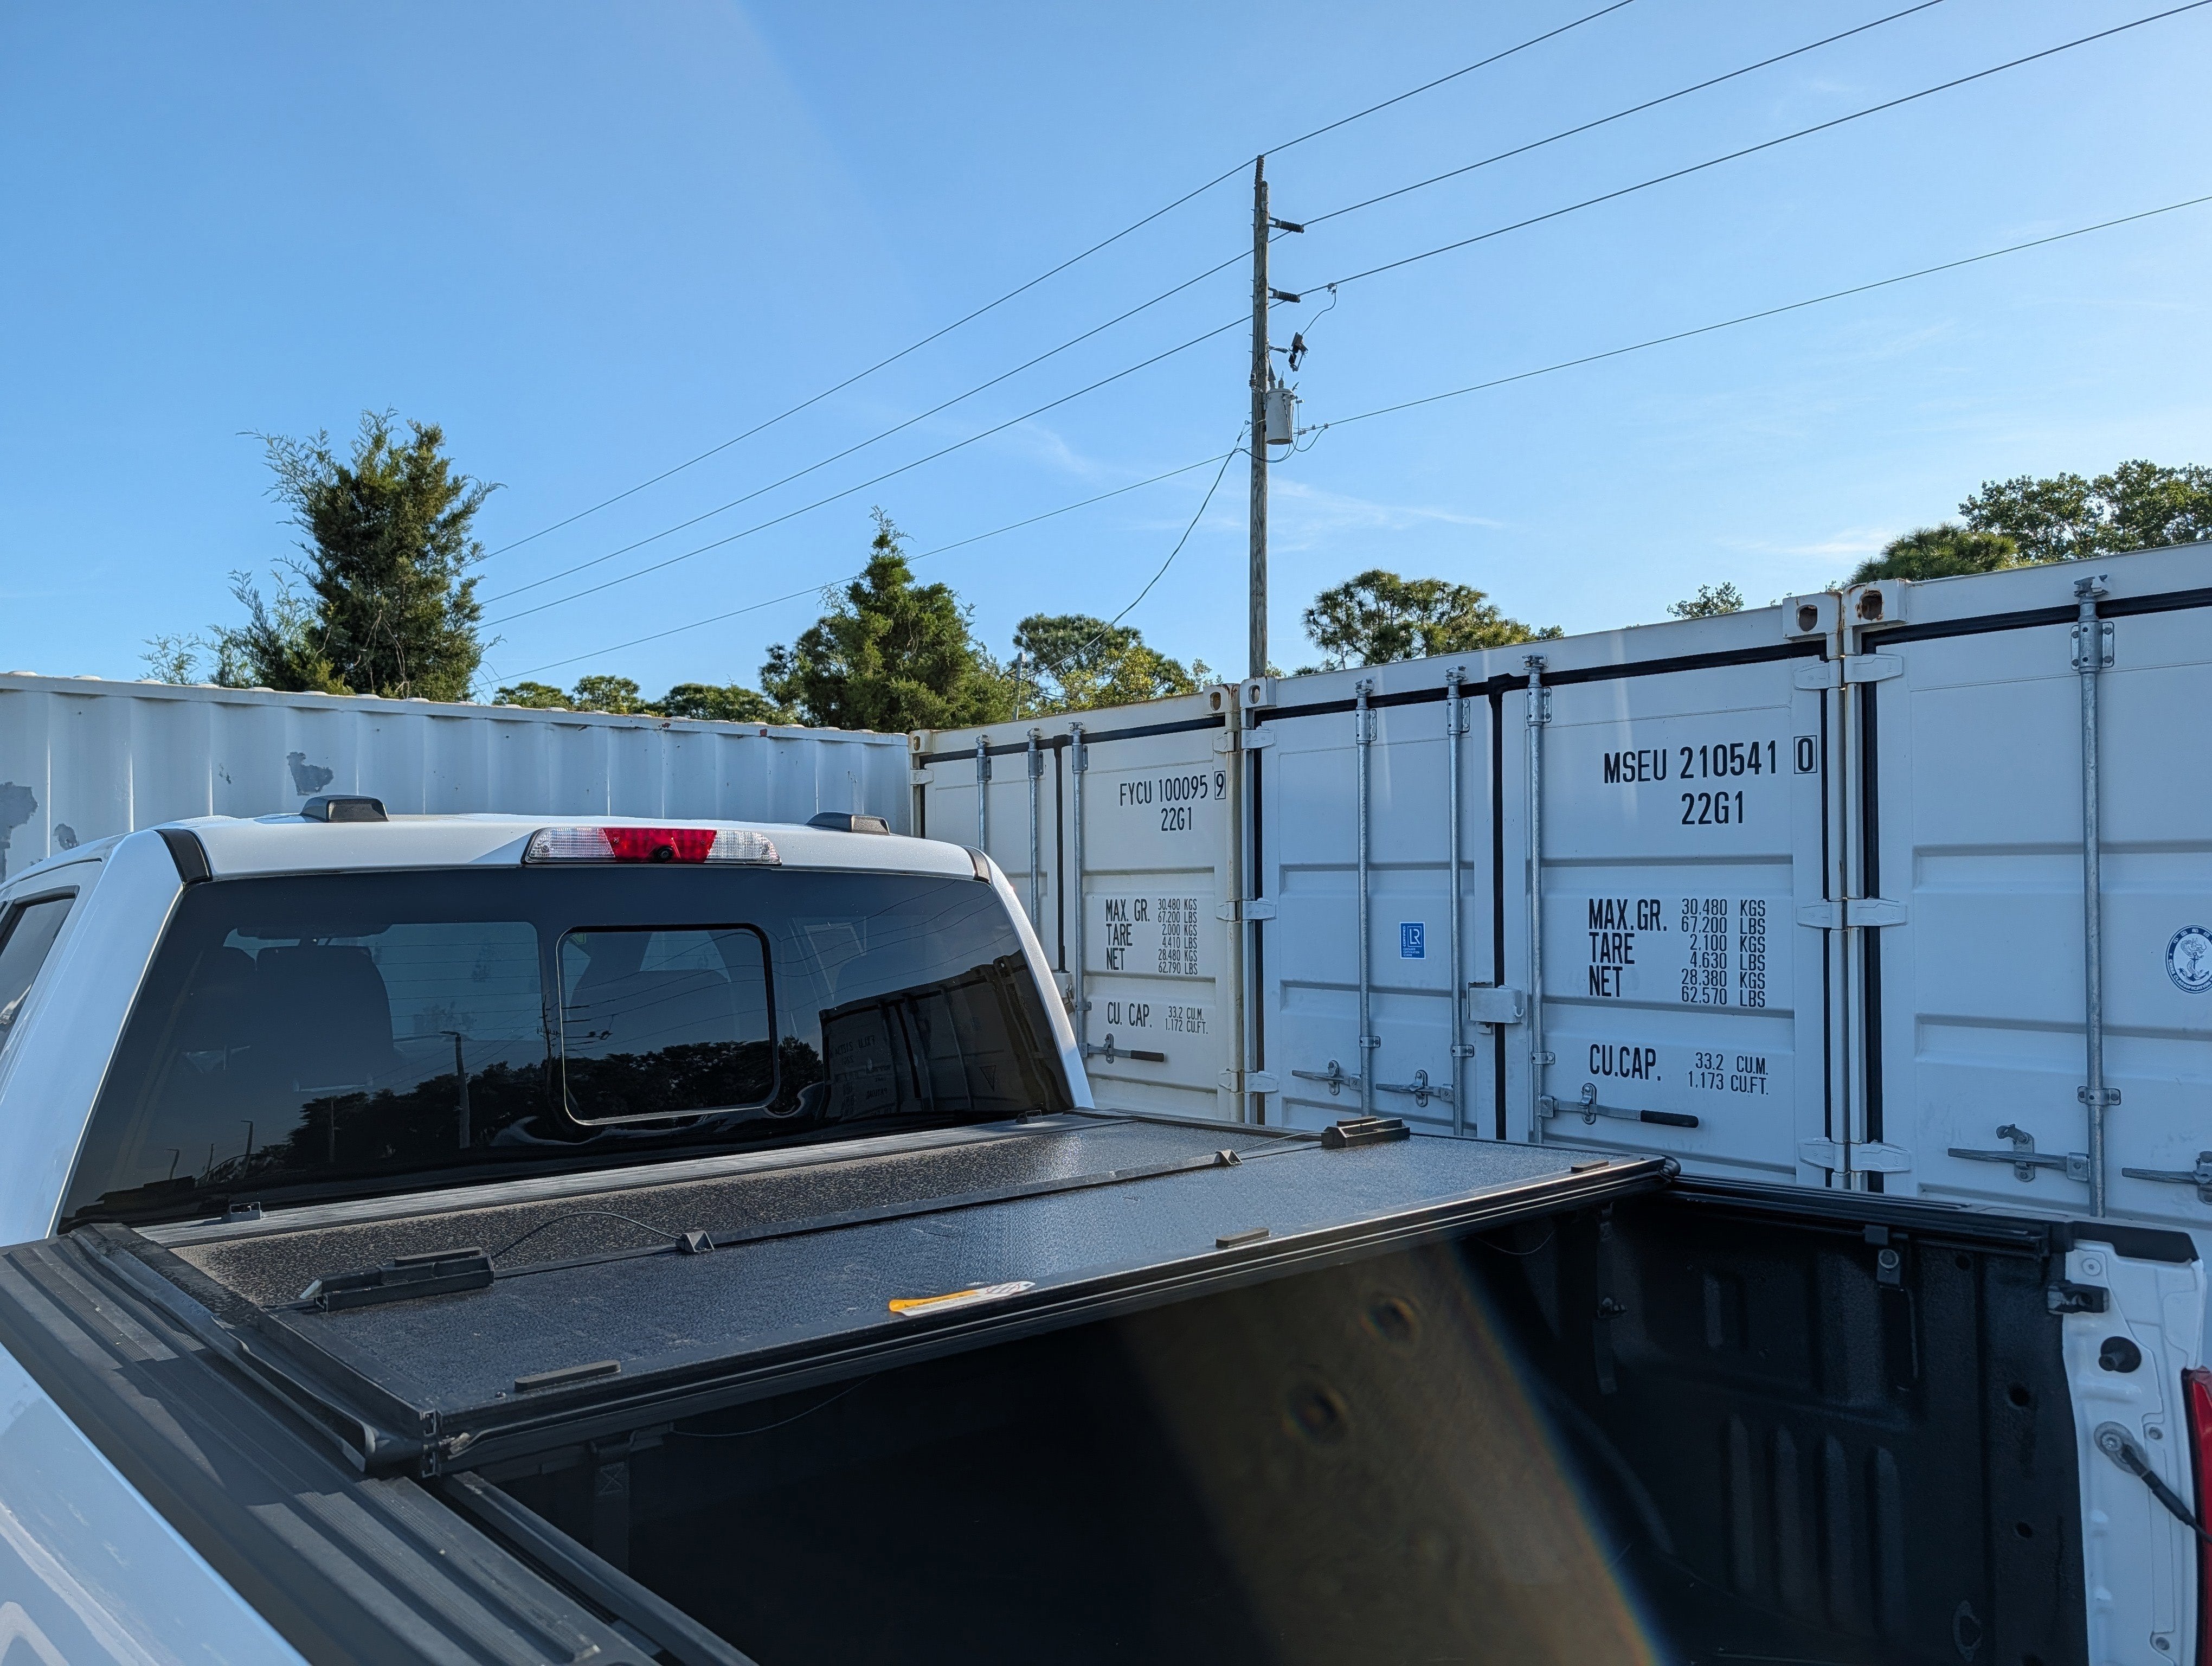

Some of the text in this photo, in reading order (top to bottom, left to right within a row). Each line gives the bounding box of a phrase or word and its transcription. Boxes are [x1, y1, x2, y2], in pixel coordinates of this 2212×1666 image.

[1604, 737, 1814, 784] MSEU 210541 0
[1120, 773, 1225, 806] FYCU 100095 9
[1681, 790, 1743, 825] 22G1
[1161, 806, 1192, 831] 22G1
[1105, 899, 1150, 921] MAX. GR.
[1184, 898, 1197, 911] KGS
[1681, 898, 1766, 917] 30,480 KGS
[1184, 911, 1197, 923] LBS
[1681, 916, 1766, 935] 67,200 LBS
[1106, 924, 1133, 946] TARE
[1184, 924, 1197, 936] KGS
[1410, 928, 1420, 945] LR
[1184, 937, 1197, 949] LBS
[1589, 932, 1635, 964] TARE
[1690, 934, 1766, 953] 2,100 KGS
[1106, 947, 1125, 970] NET
[1185, 950, 1198, 962] KGS
[1690, 951, 1766, 971] 4,630 LBS
[1185, 963, 1198, 975] LBS
[1681, 968, 1766, 989] 28,380 KGS
[1589, 965, 1623, 997] NET
[1681, 986, 1766, 1008] 62,570 LBS
[1107, 1002, 1122, 1025] CU.
[1168, 1005, 1204, 1021] 33.2 CU.M.
[1165, 1018, 1208, 1034] 1,172 CU.FT.
[1695, 1052, 1769, 1075] 33.2 CU.M.
[1688, 1071, 1769, 1095] 1,173 CU.FT.
